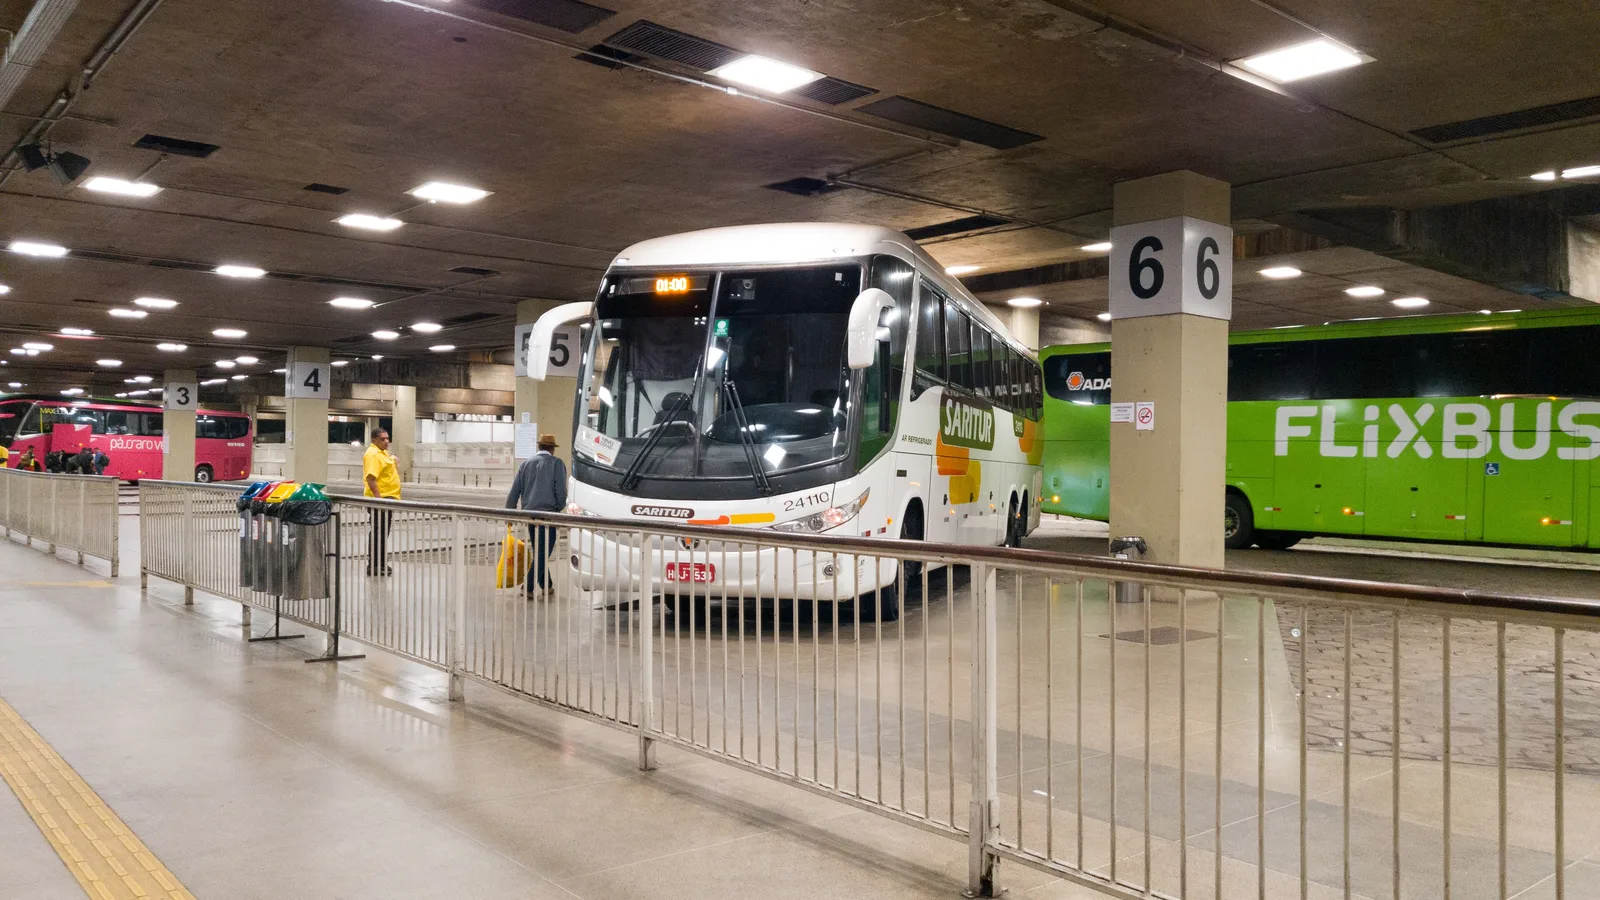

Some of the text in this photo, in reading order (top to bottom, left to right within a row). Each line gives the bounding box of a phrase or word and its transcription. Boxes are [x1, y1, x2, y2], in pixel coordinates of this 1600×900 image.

[1129, 235, 1164, 299] 6
[1197, 236, 1220, 300] 6
[656, 277, 687, 292] 01:00
[549, 333, 570, 367] 5
[303, 368, 322, 392] 4
[176, 387, 190, 405] 3
[944, 398, 993, 443] SARITUR
[901, 434, 933, 446] AR REFRIGERADO
[633, 506, 690, 518] SARITUR
[783, 491, 830, 512] 24110
[667, 569, 713, 581] HJ-53
